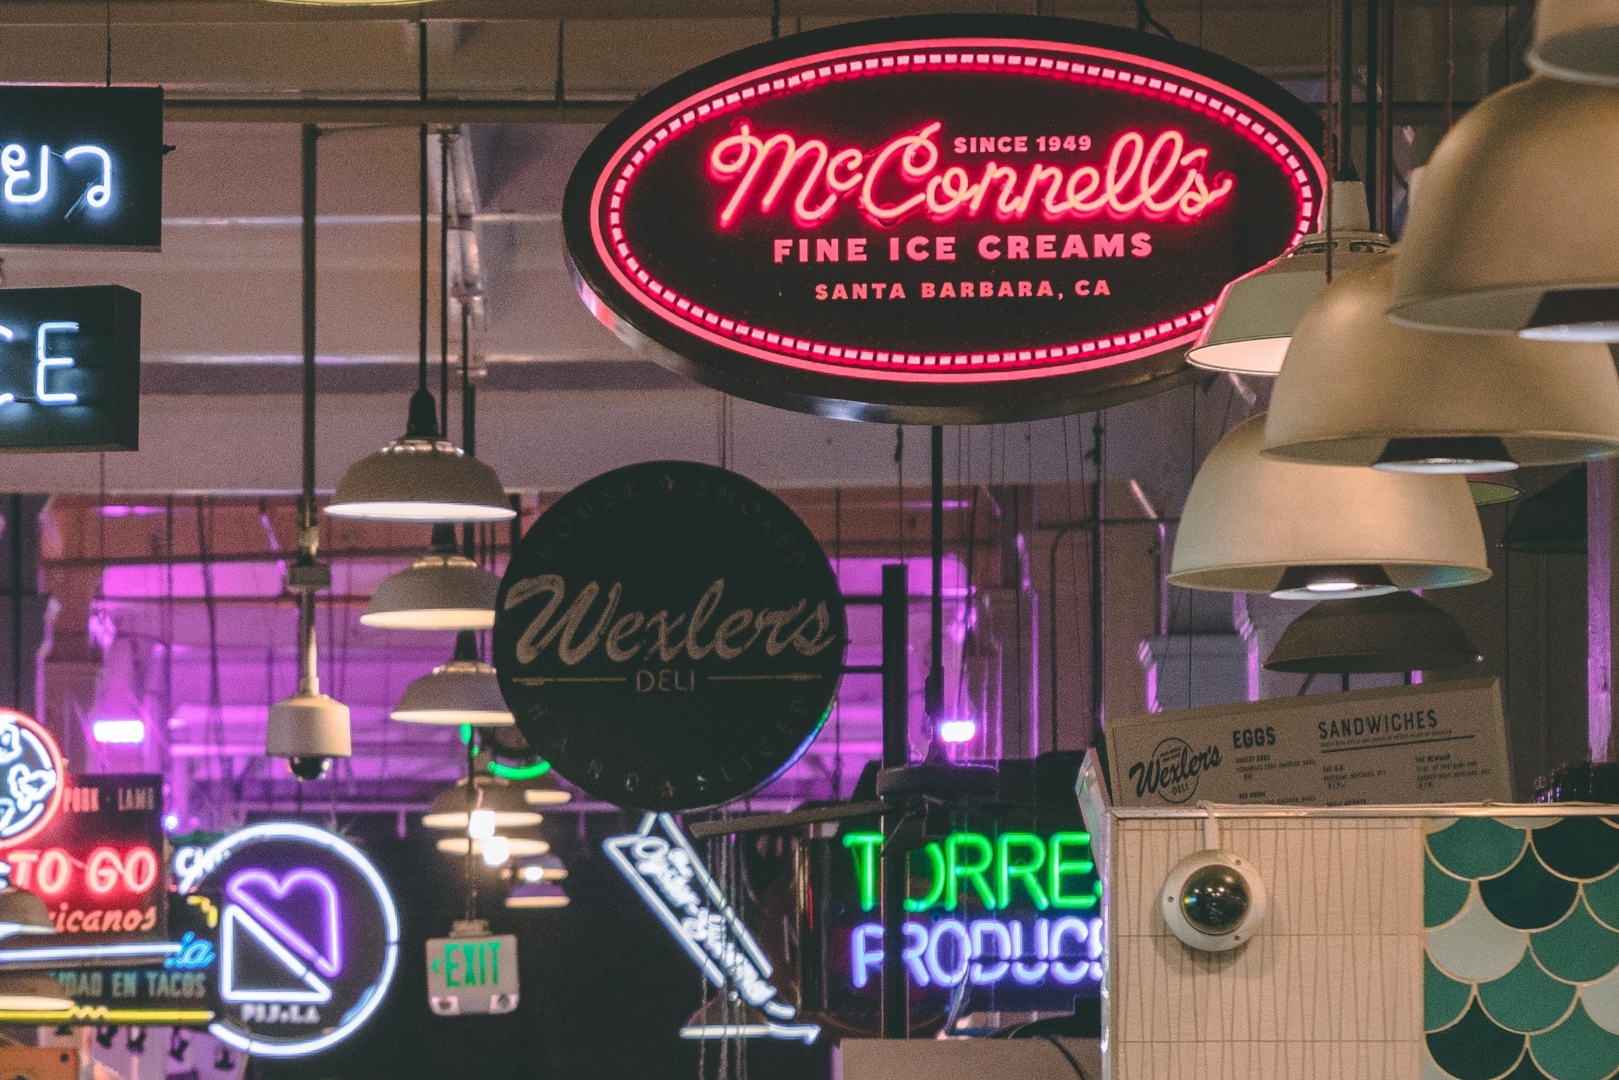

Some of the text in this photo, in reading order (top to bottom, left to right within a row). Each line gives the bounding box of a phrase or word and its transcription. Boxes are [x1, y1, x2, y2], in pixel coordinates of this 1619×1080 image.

[953, 135, 1093, 154] SINCE 1949
[710, 121, 1234, 229] McConnell's
[773, 232, 1154, 265] FINE ICE CREAMS
[814, 279, 1112, 303] SANTA BARBARA, CA
[635, 668, 697, 694] DELI
[1231, 726, 1277, 750] EGGS
[1317, 709, 1439, 740] SANDWICHES
[1128, 738, 1223, 799] Wexler's
[8, 850, 70, 894] TO
[86, 849, 157, 894] GO
[842, 831, 1103, 912] TORRE
[444, 941, 503, 988] EXIT
[111, 971, 138, 997] EN
[145, 971, 207, 998] TACOS
